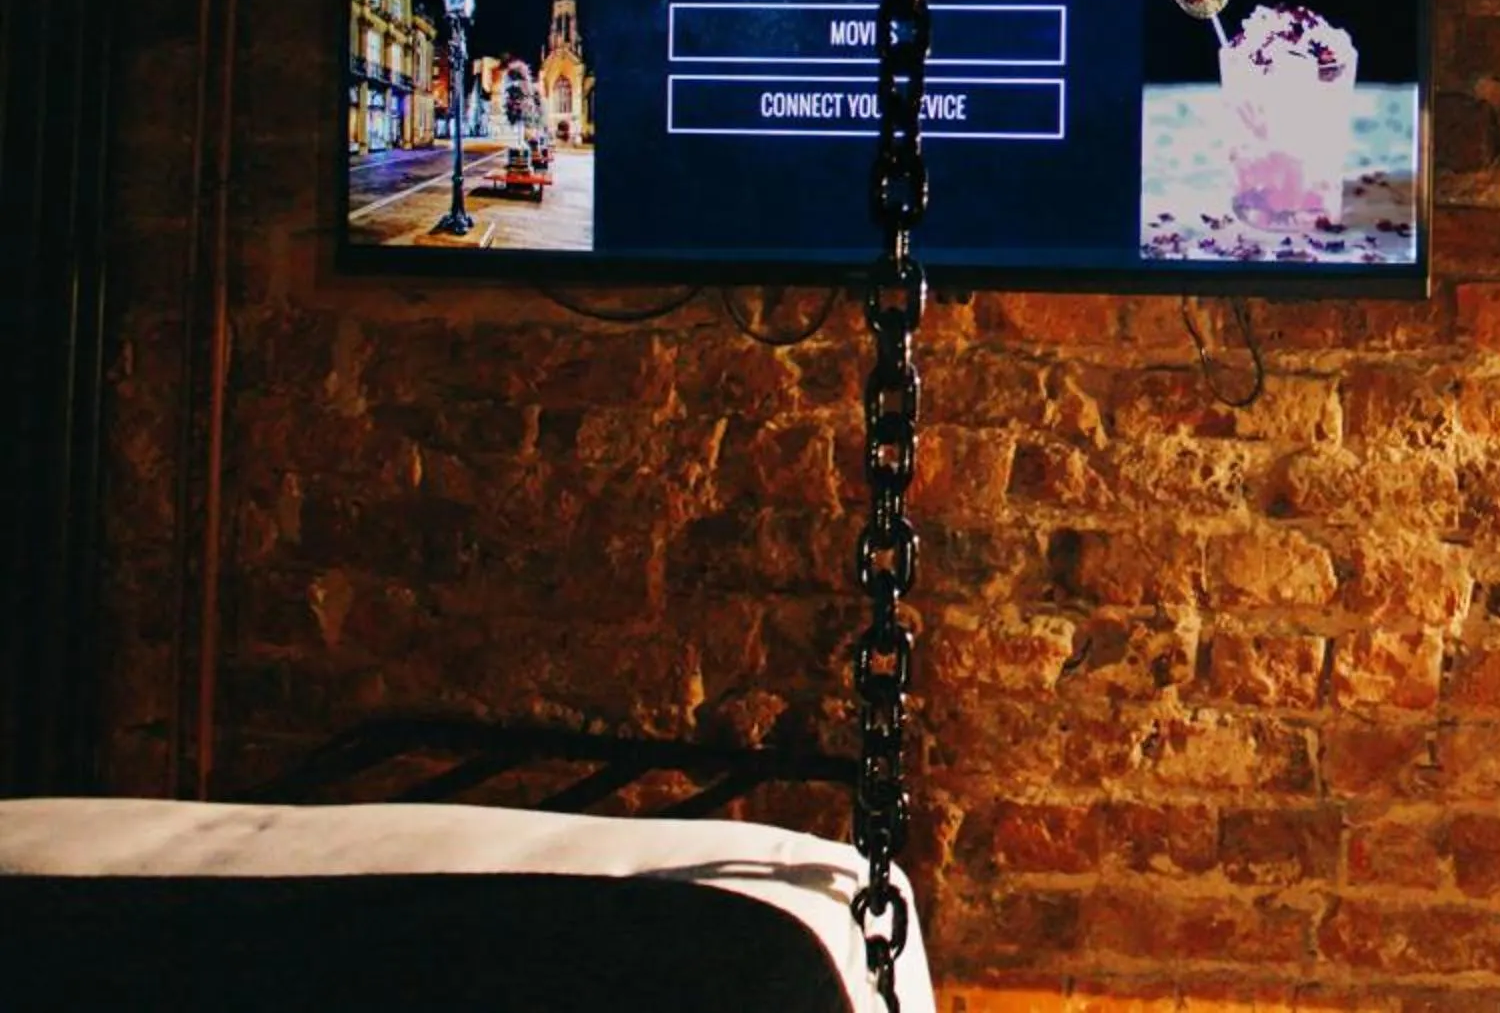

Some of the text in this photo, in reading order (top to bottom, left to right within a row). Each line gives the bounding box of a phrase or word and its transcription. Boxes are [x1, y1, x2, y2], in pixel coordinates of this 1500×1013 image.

[831, 21, 898, 46] MOVIS
[761, 92, 967, 120] CONNECT YOU EVICE
